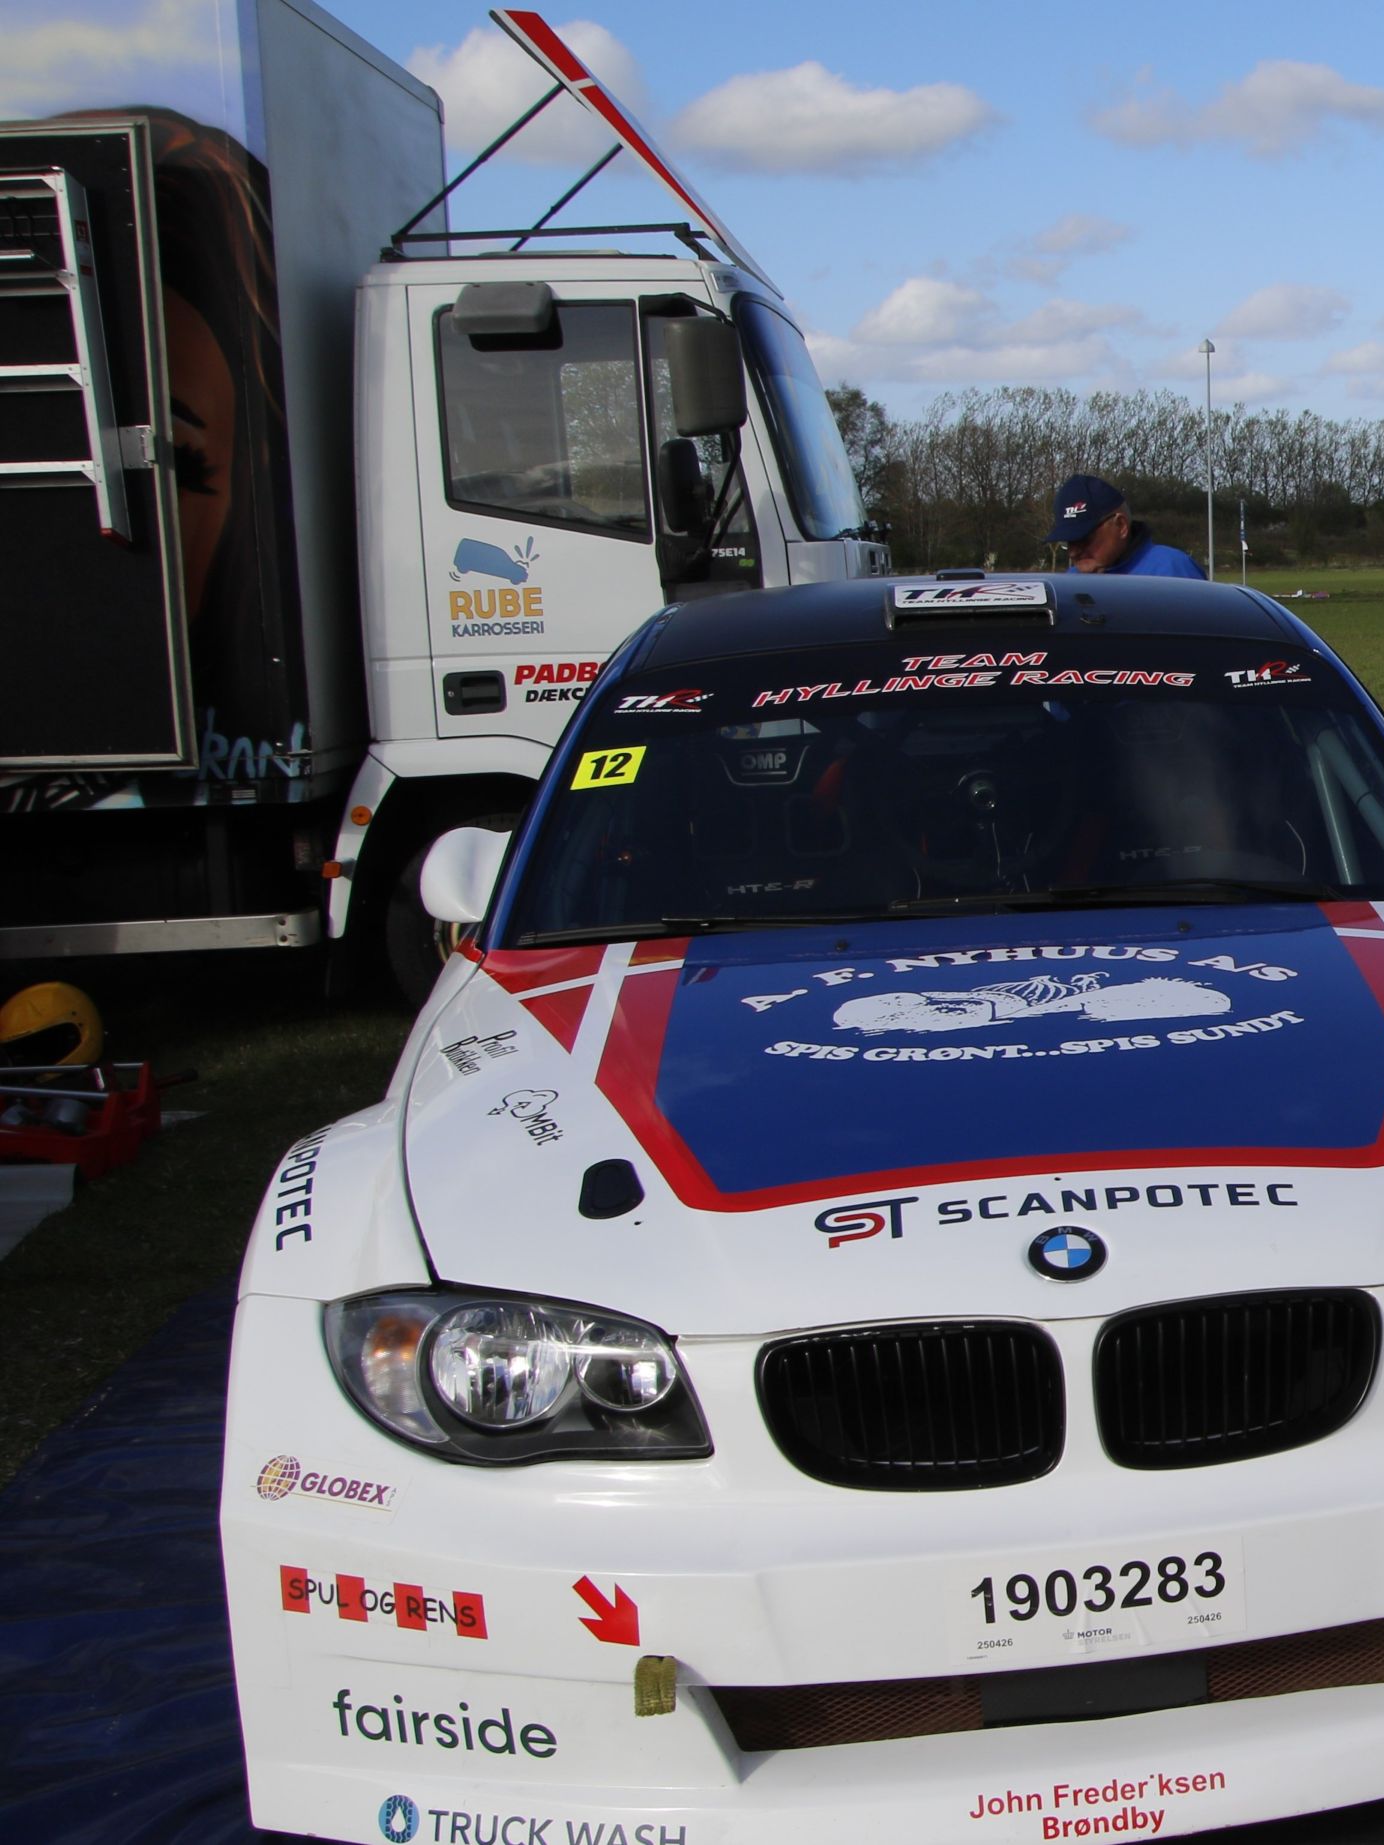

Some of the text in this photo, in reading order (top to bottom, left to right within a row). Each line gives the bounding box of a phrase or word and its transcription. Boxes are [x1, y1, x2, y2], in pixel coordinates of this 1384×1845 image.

[711, 547, 746, 558] 75E14
[449, 587, 543, 620] RUBE
[451, 620, 544, 638] KARROSSERI
[514, 662, 606, 685] PADB
[902, 652, 1048, 671] TEAM
[525, 688, 591, 703] DÆKC
[752, 670, 1196, 708] HYLLINGE RACING
[587, 753, 633, 781] 12
[740, 752, 787, 770] OMP
[741, 946, 1298, 1013] A. F. NYHUUS A/S
[765, 1041, 859, 1061] SPIS
[1170, 1011, 1304, 1045] SUNDT
[938, 1183, 1299, 1226] SCANPOTEC
[1035, 1226, 1096, 1246] BMW
[300, 1472, 390, 1505] GLOBEX
[971, 1551, 1225, 1624] 1903283
[288, 1578, 476, 1627] SPUL OG RENS
[1187, 1612, 1222, 1625] 250426
[977, 1638, 1013, 1650] 250426
[1077, 1628, 1112, 1638] MOTOR
[332, 1688, 558, 1758] fairside
[969, 1791, 1043, 1819] John
[428, 1808, 686, 1845] TRUCK WASH
[1042, 1806, 1165, 1840] Brøndby
